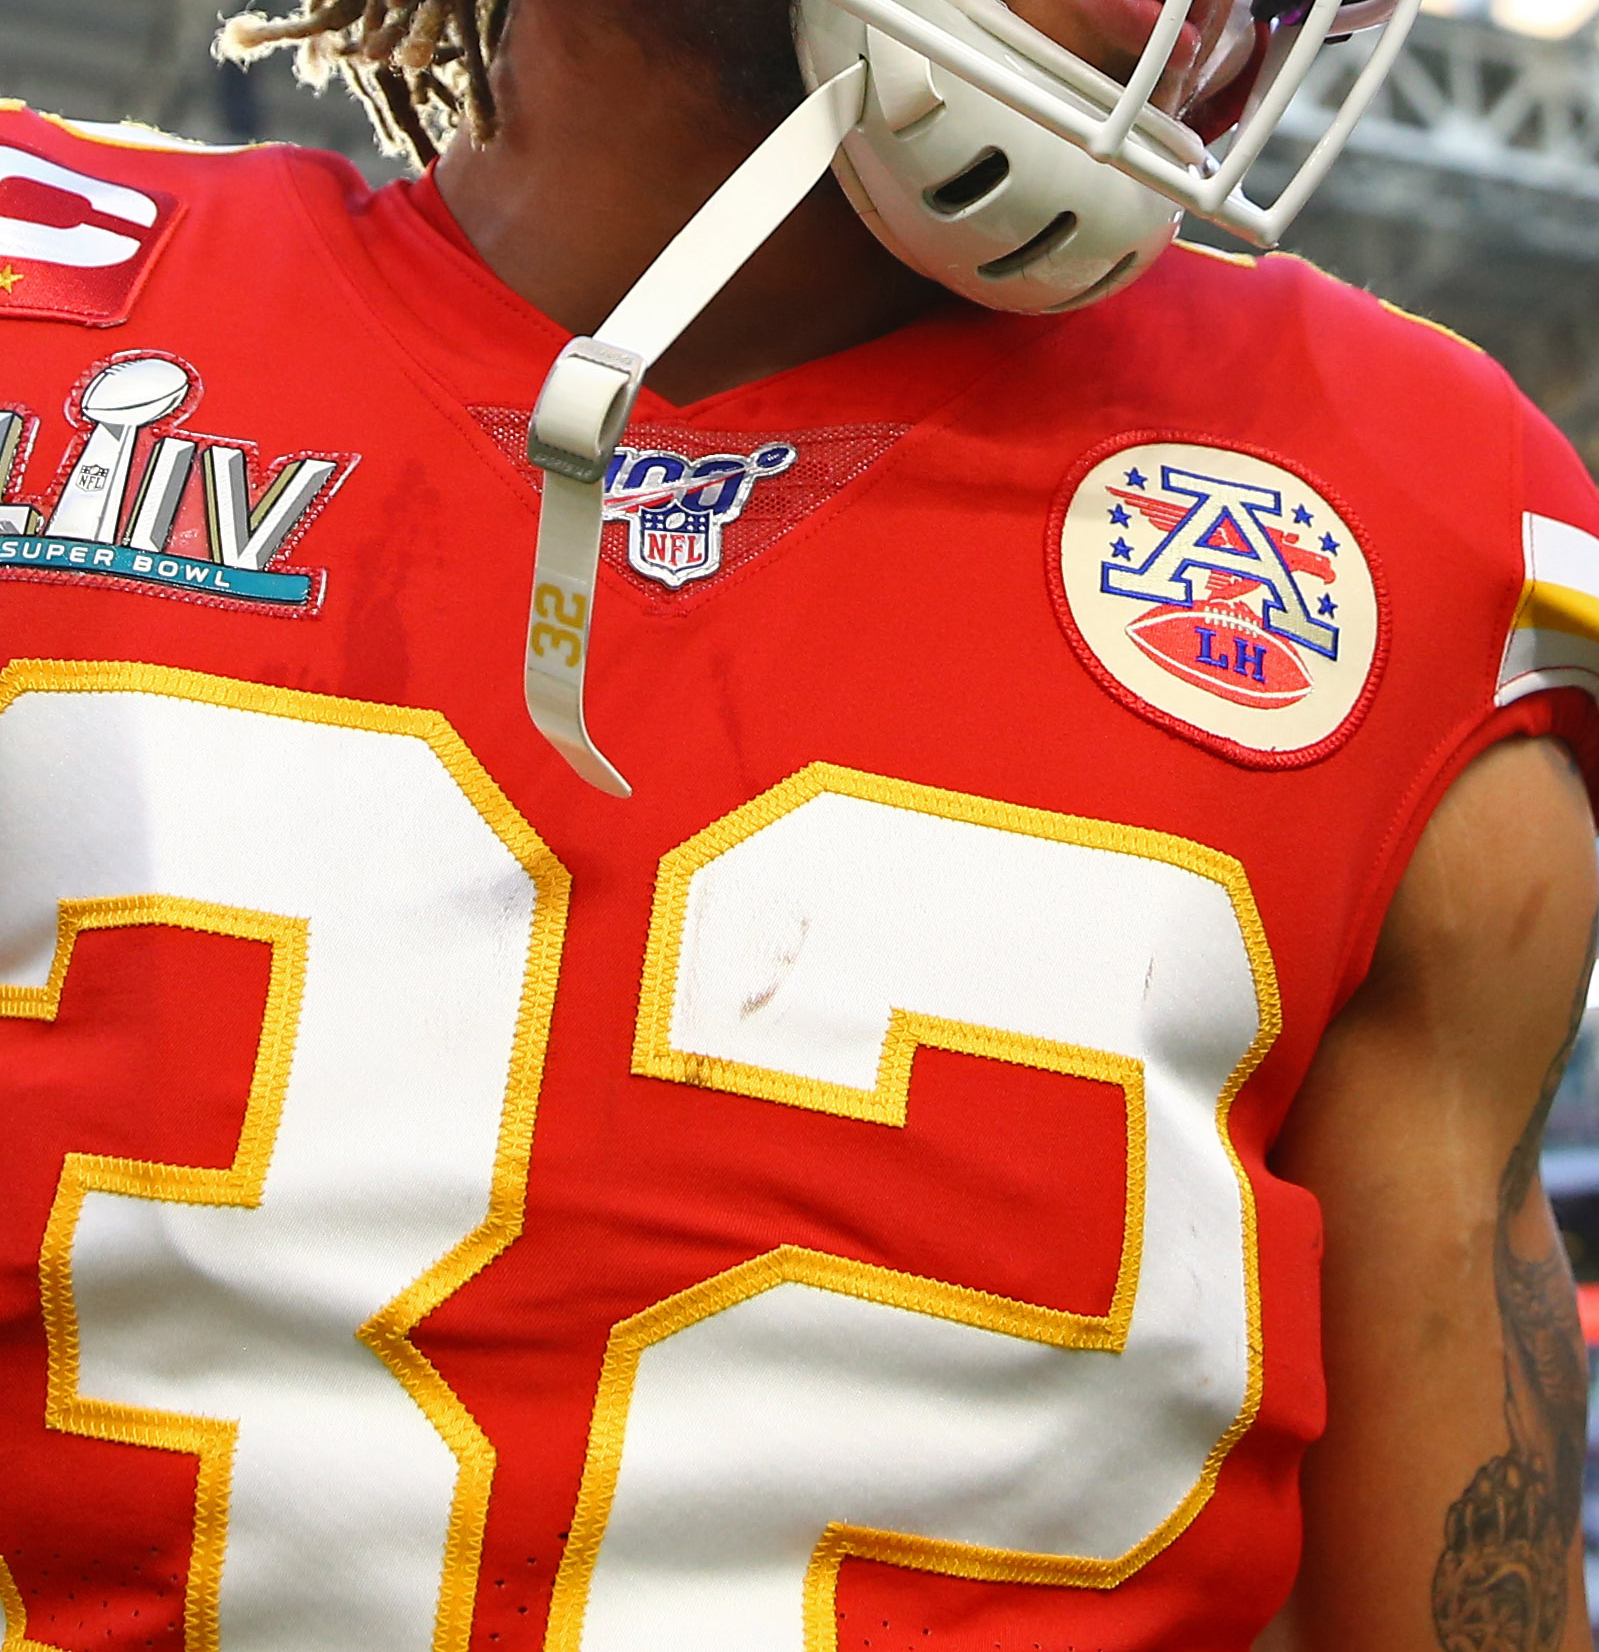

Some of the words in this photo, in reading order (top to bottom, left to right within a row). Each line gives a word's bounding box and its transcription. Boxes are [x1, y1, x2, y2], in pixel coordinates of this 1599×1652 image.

[79, 474, 103, 489] NFL
[0, 539, 114, 567] SUPER
[132, 555, 231, 588] BOWL
[647, 533, 703, 567] NFL
[1100, 465, 1340, 662] A
[531, 582, 586, 668] 32
[1195, 626, 1268, 683] LH
